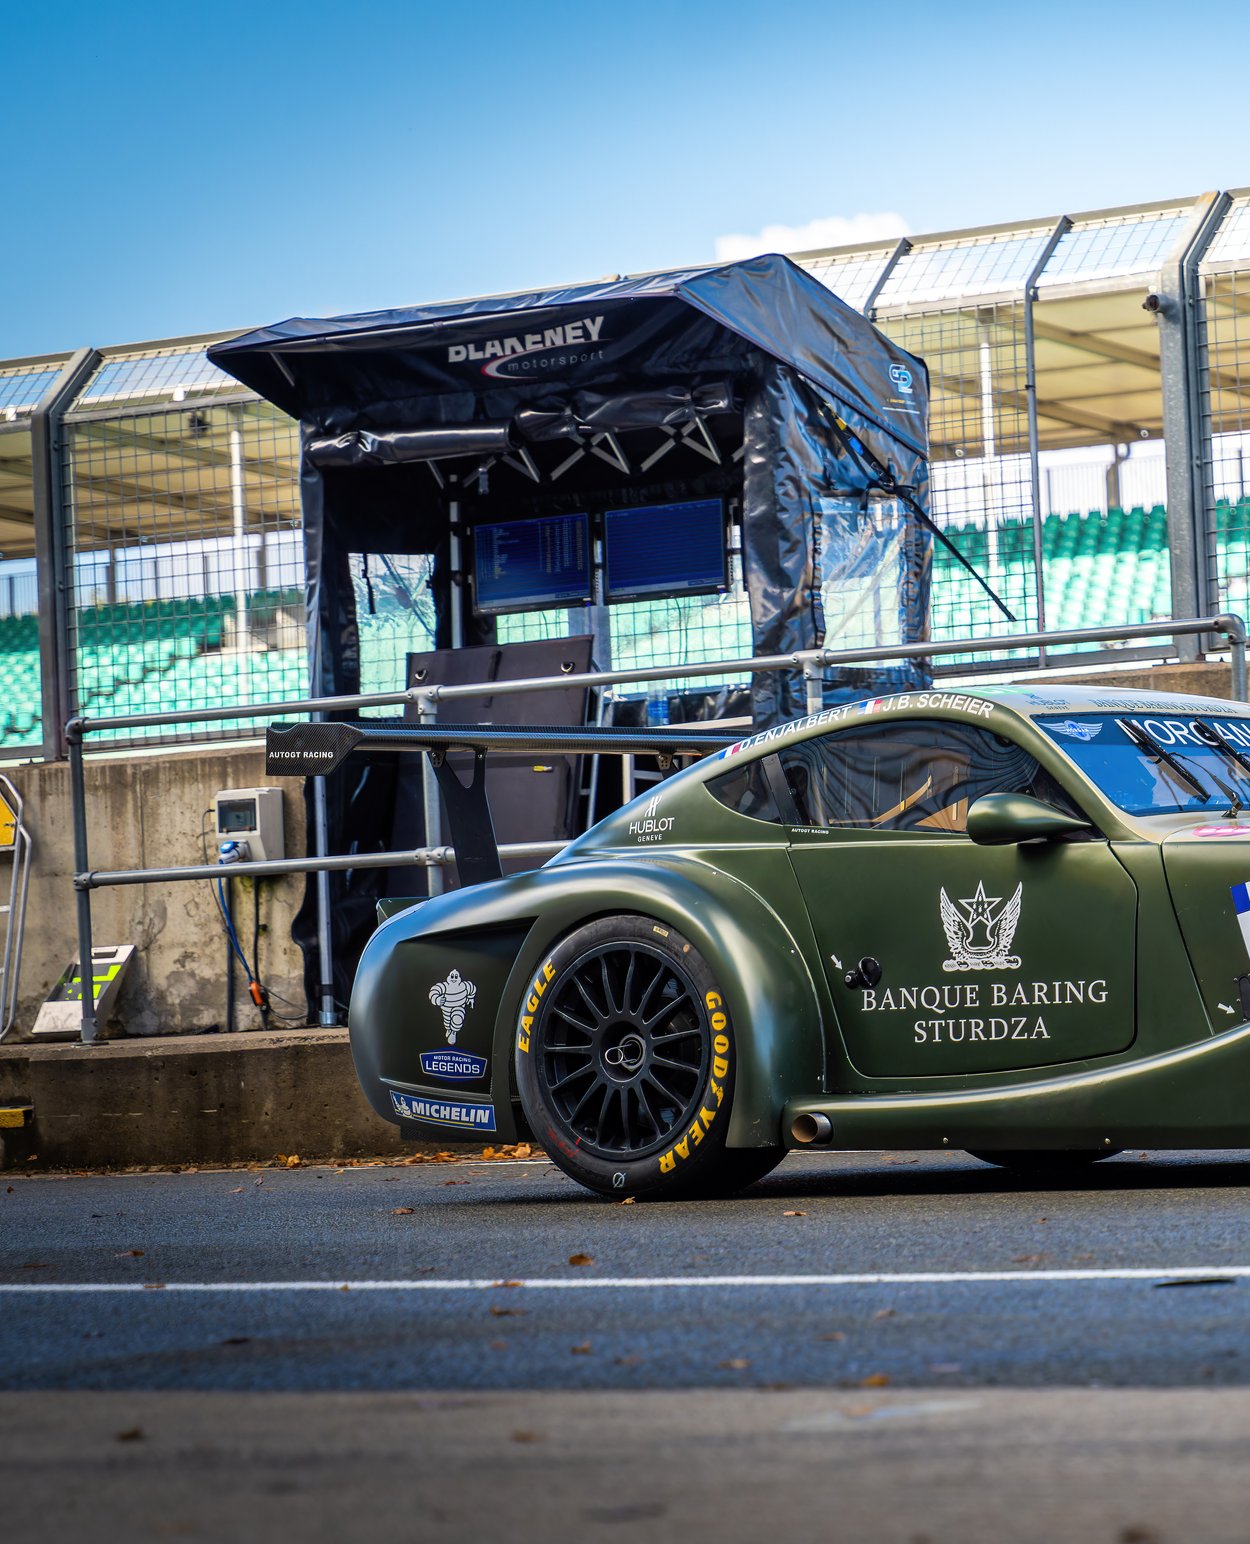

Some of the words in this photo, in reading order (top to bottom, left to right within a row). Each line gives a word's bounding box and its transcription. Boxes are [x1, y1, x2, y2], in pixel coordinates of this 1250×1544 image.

[508, 350, 604, 371] motorsport
[917, 693, 995, 719] SCHEIER
[268, 751, 301, 759] AUTOGT
[303, 751, 334, 759] RACING
[628, 817, 675, 835] HUBLOT
[637, 833, 663, 843] GENEVE
[517, 958, 557, 1054] EAGLE
[861, 984, 980, 1014] BANQUE
[990, 979, 1109, 1007] BARING
[914, 1016, 1051, 1043] STURDZA
[425, 1060, 480, 1074] LEGENDS
[412, 1100, 490, 1124] MICHELIN
